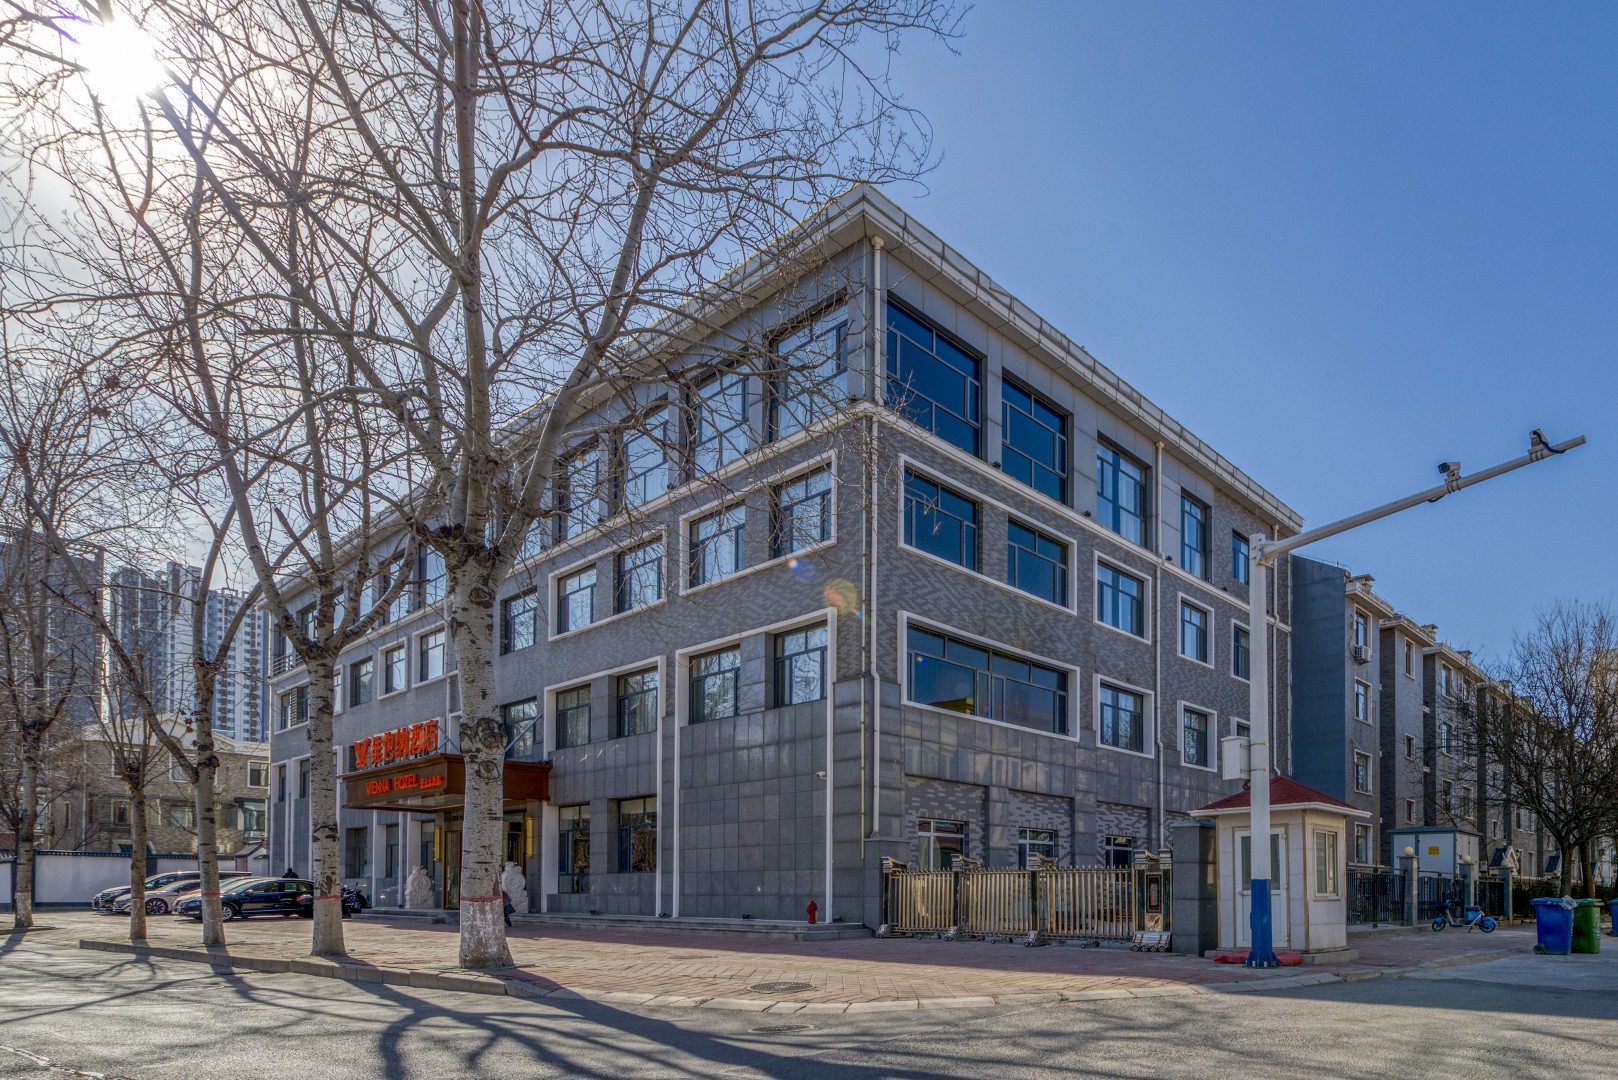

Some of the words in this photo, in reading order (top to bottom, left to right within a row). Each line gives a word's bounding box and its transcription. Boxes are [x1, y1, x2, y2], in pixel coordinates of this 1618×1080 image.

[371, 719, 438, 764] 维也纳酒店
[366, 779, 391, 795] VIENNA
[395, 774, 418, 790] HOTEL
